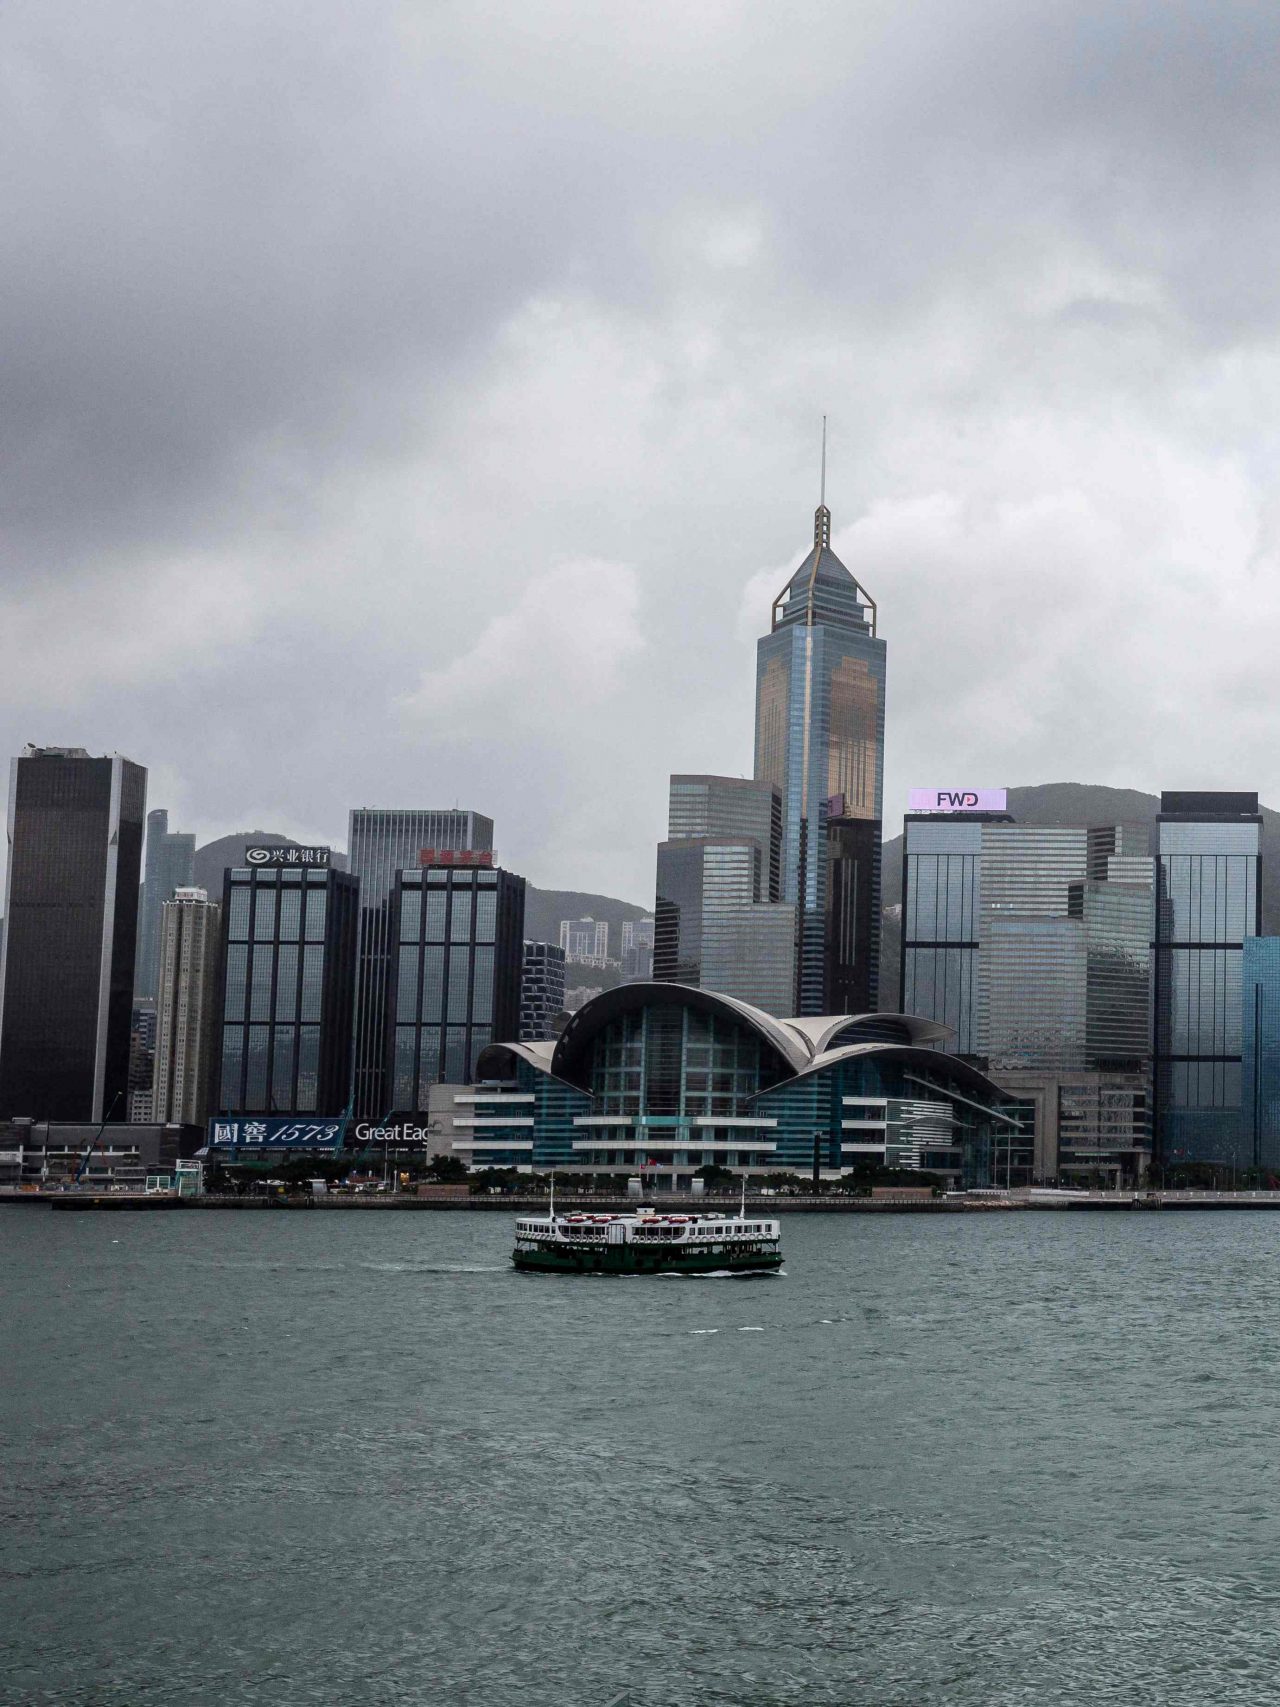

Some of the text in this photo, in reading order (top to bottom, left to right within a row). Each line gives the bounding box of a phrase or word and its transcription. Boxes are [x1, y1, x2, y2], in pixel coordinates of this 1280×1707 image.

[937, 792, 979, 807] FWD
[271, 849, 329, 863] 兴业银行
[214, 1122, 340, 1144] 國窖 1573
[355, 1123, 401, 1141] Great
